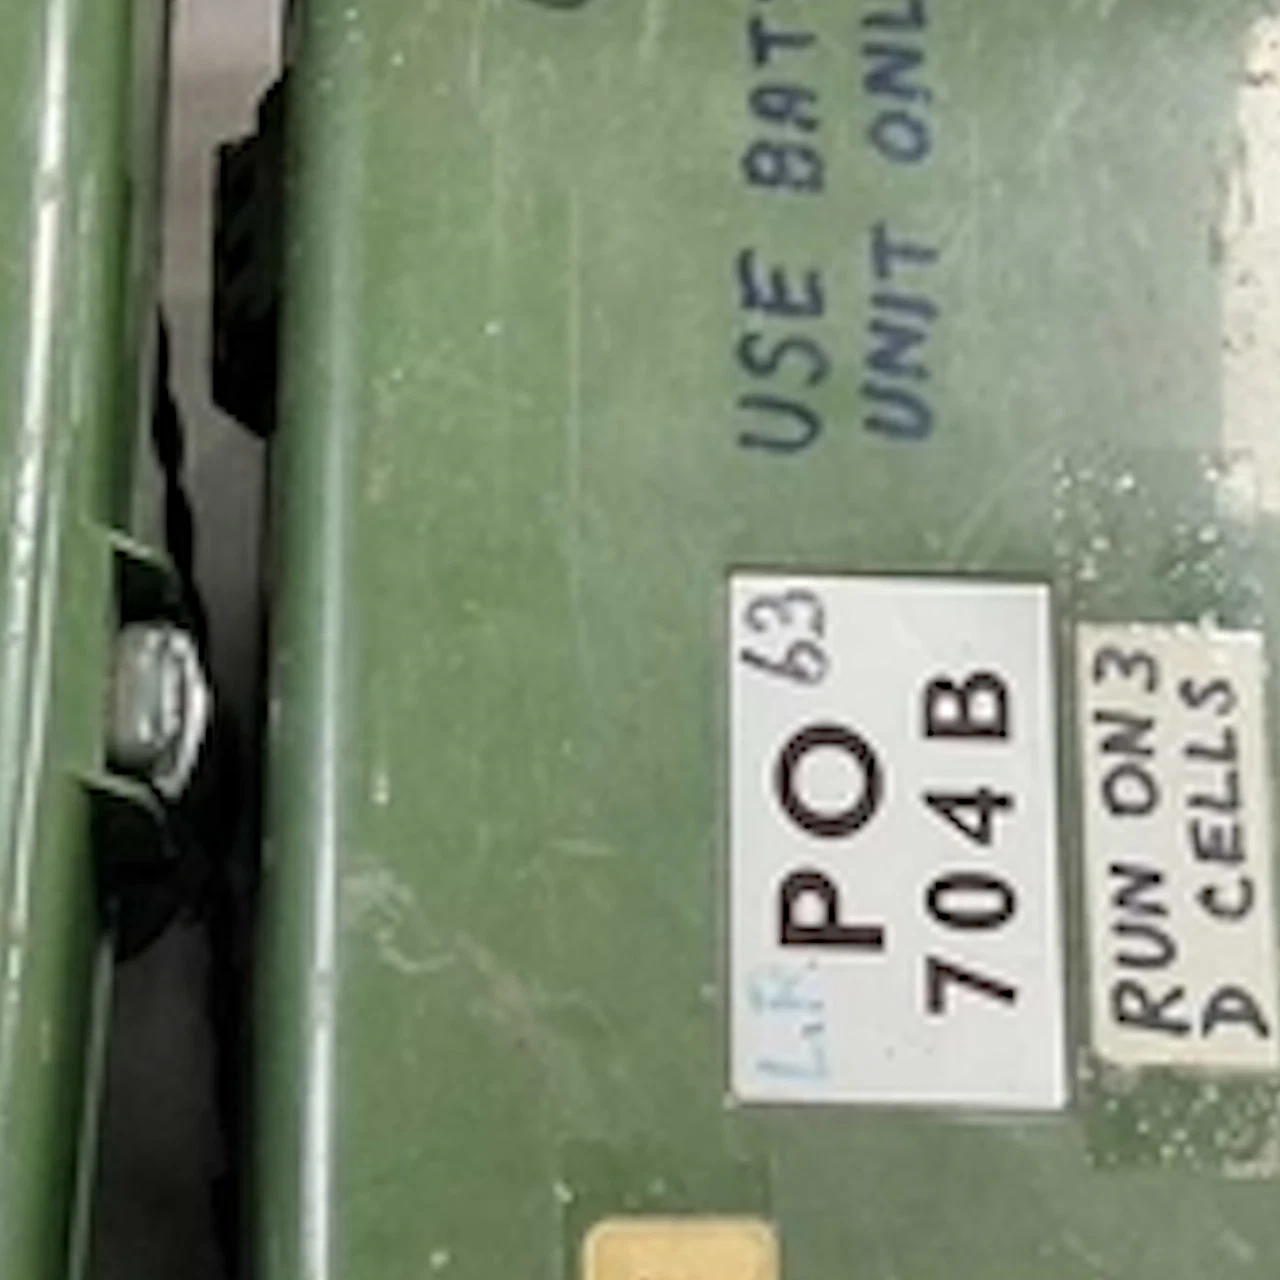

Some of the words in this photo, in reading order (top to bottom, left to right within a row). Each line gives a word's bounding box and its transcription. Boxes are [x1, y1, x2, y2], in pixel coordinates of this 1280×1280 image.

[734, 245, 833, 455] USE
[860, 219, 940, 441] UNIT
[739, 587, 830, 686] 63
[1093, 646, 1160, 693] 3
[772, 721, 885, 955] PO
[1094, 708, 1160, 819] ON
[1179, 676, 1256, 922] CELLS
[1108, 863, 1192, 1037] RUN
[1200, 985, 1272, 1039] D
